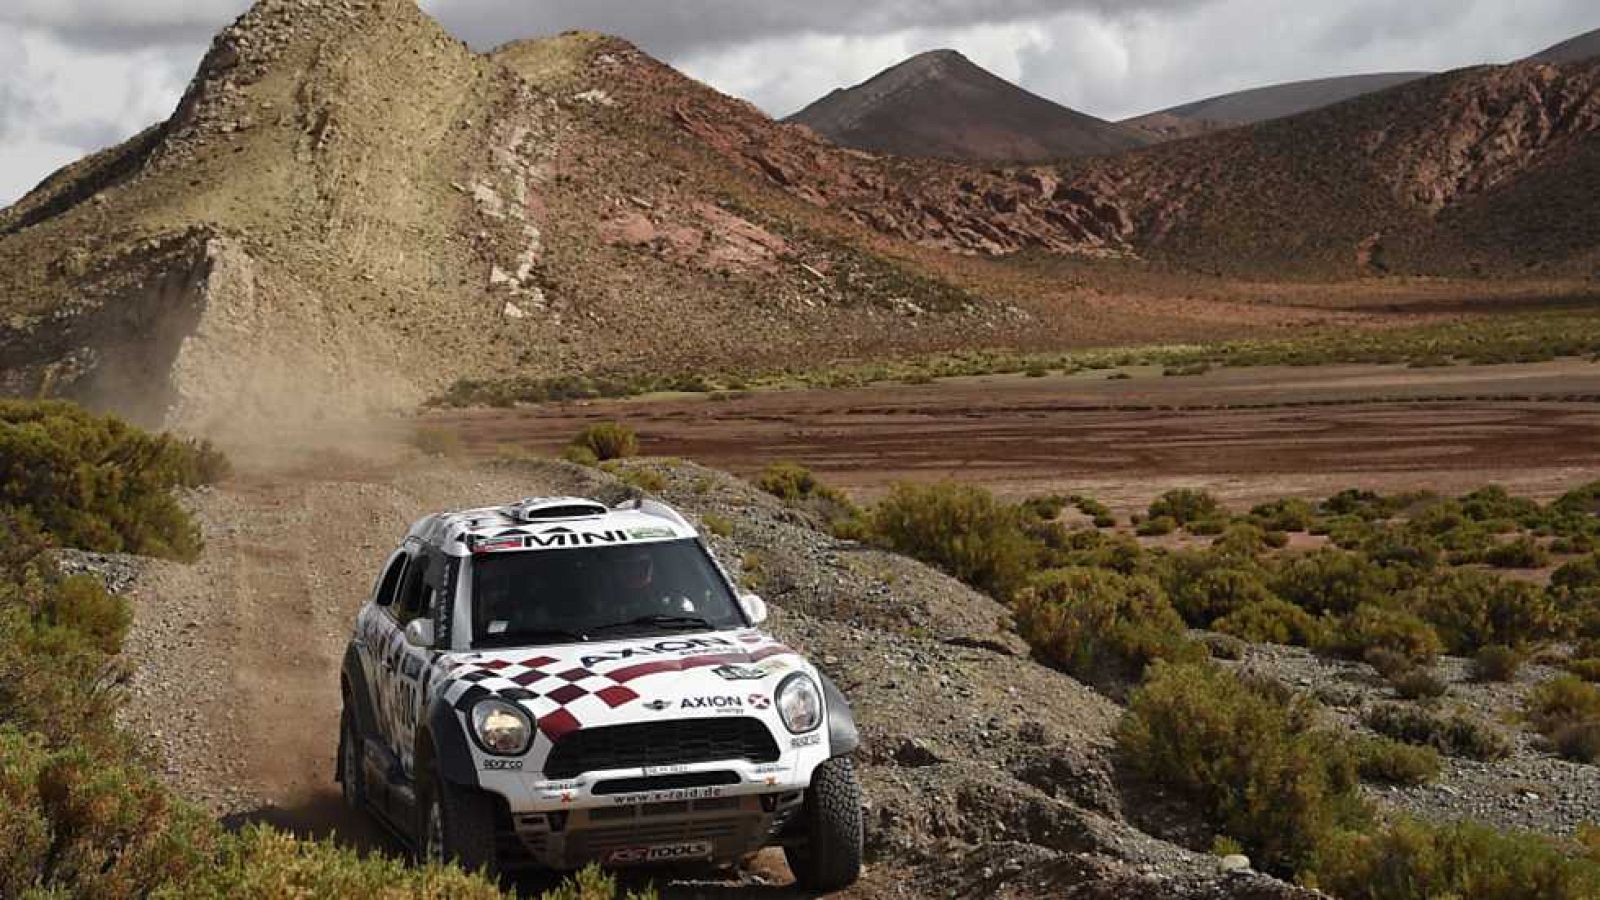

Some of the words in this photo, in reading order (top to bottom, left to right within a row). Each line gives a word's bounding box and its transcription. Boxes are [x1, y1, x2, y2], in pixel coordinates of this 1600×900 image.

[523, 530, 628, 547] MINI
[580, 637, 733, 668] AXION
[680, 695, 743, 709] AXION
[613, 785, 722, 804] www.x-raid.de
